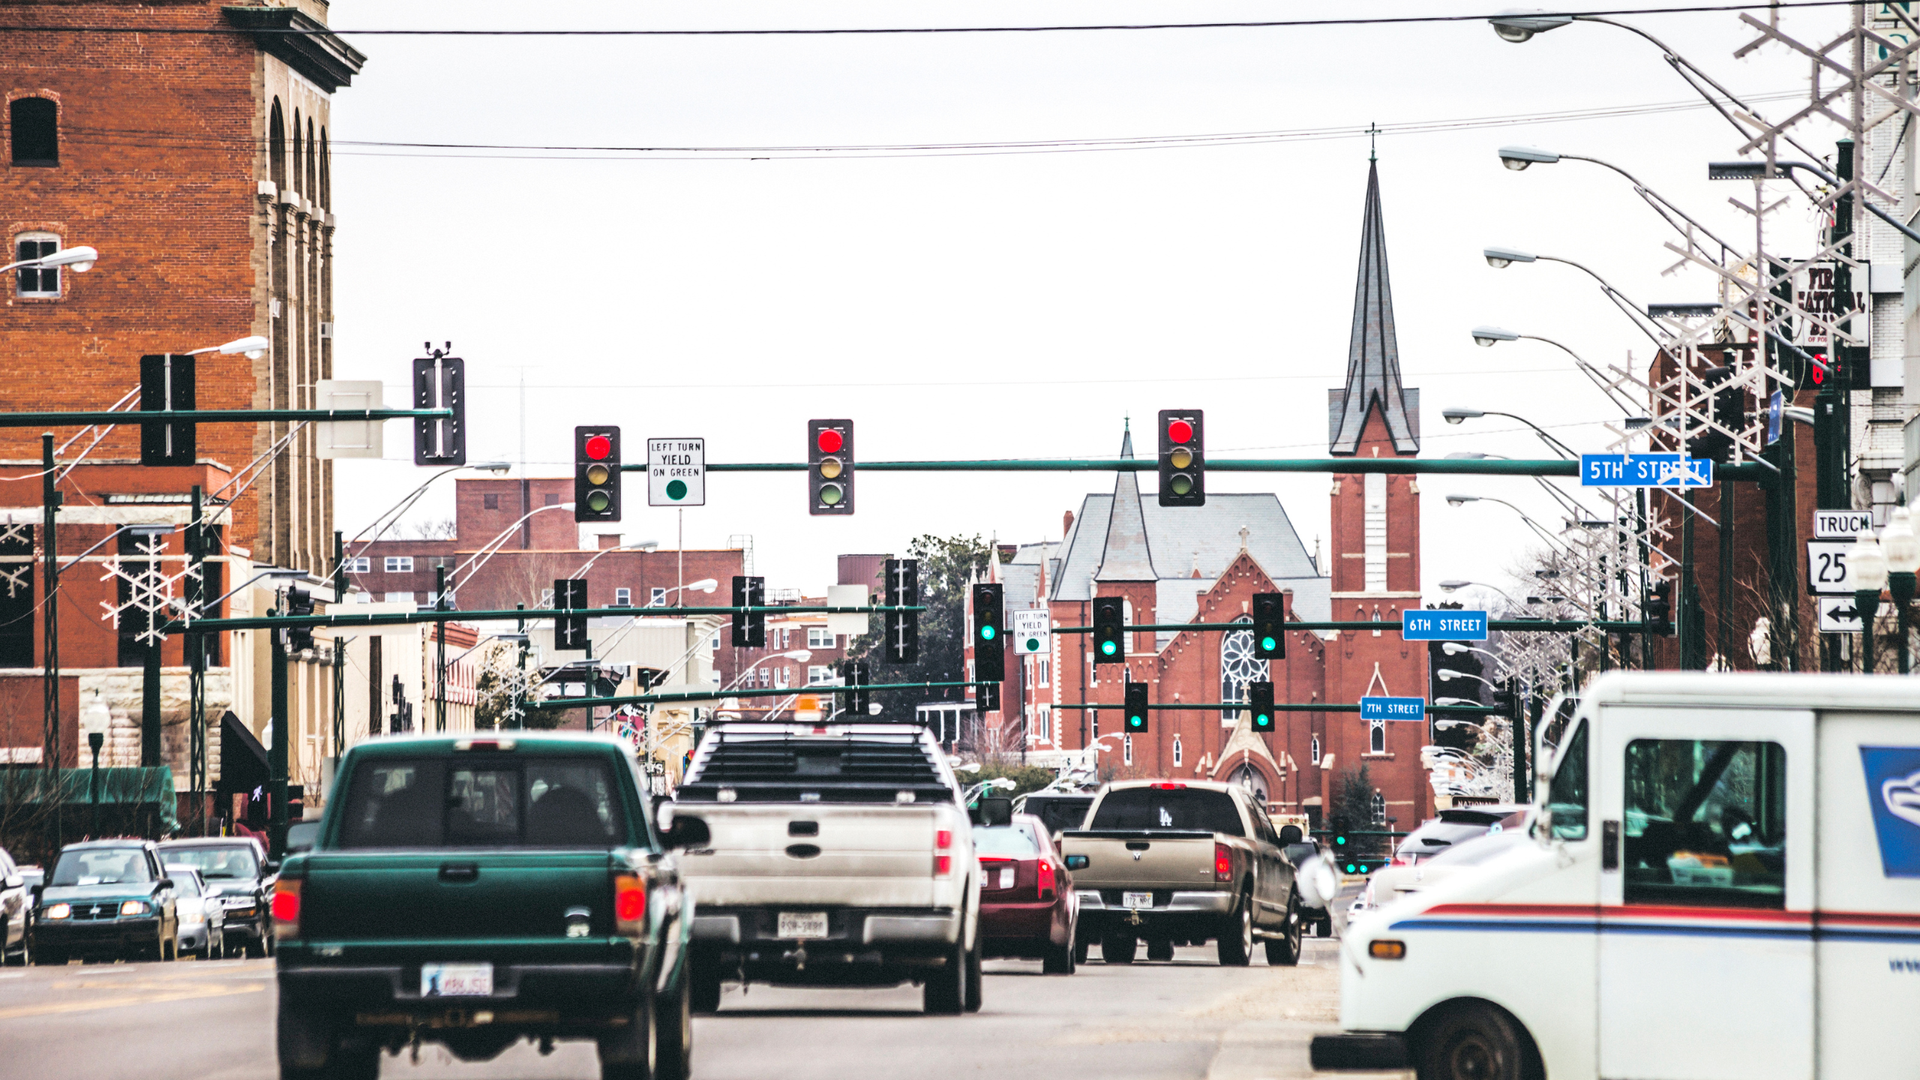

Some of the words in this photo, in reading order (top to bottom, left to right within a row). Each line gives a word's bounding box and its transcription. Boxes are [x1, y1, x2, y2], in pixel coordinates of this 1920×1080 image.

[1797, 291, 1866, 313] NATIOAL
[651, 443, 673, 451] LEFT
[677, 442, 701, 451] TURN
[661, 454, 691, 465] YIELD
[653, 468, 665, 477] ON
[670, 468, 699, 477] GREEN
[1590, 461, 1623, 479] 5TH
[1819, 516, 1869, 532] TRUCK
[1022, 621, 1042, 629] YIELD
[1409, 619, 1431, 631] 6TH
[1439, 619, 1482, 631] STREET
[1366, 703, 1382, 713] 7TH
[1387, 704, 1420, 714] STREET
[1159, 806, 1173, 827] LA
